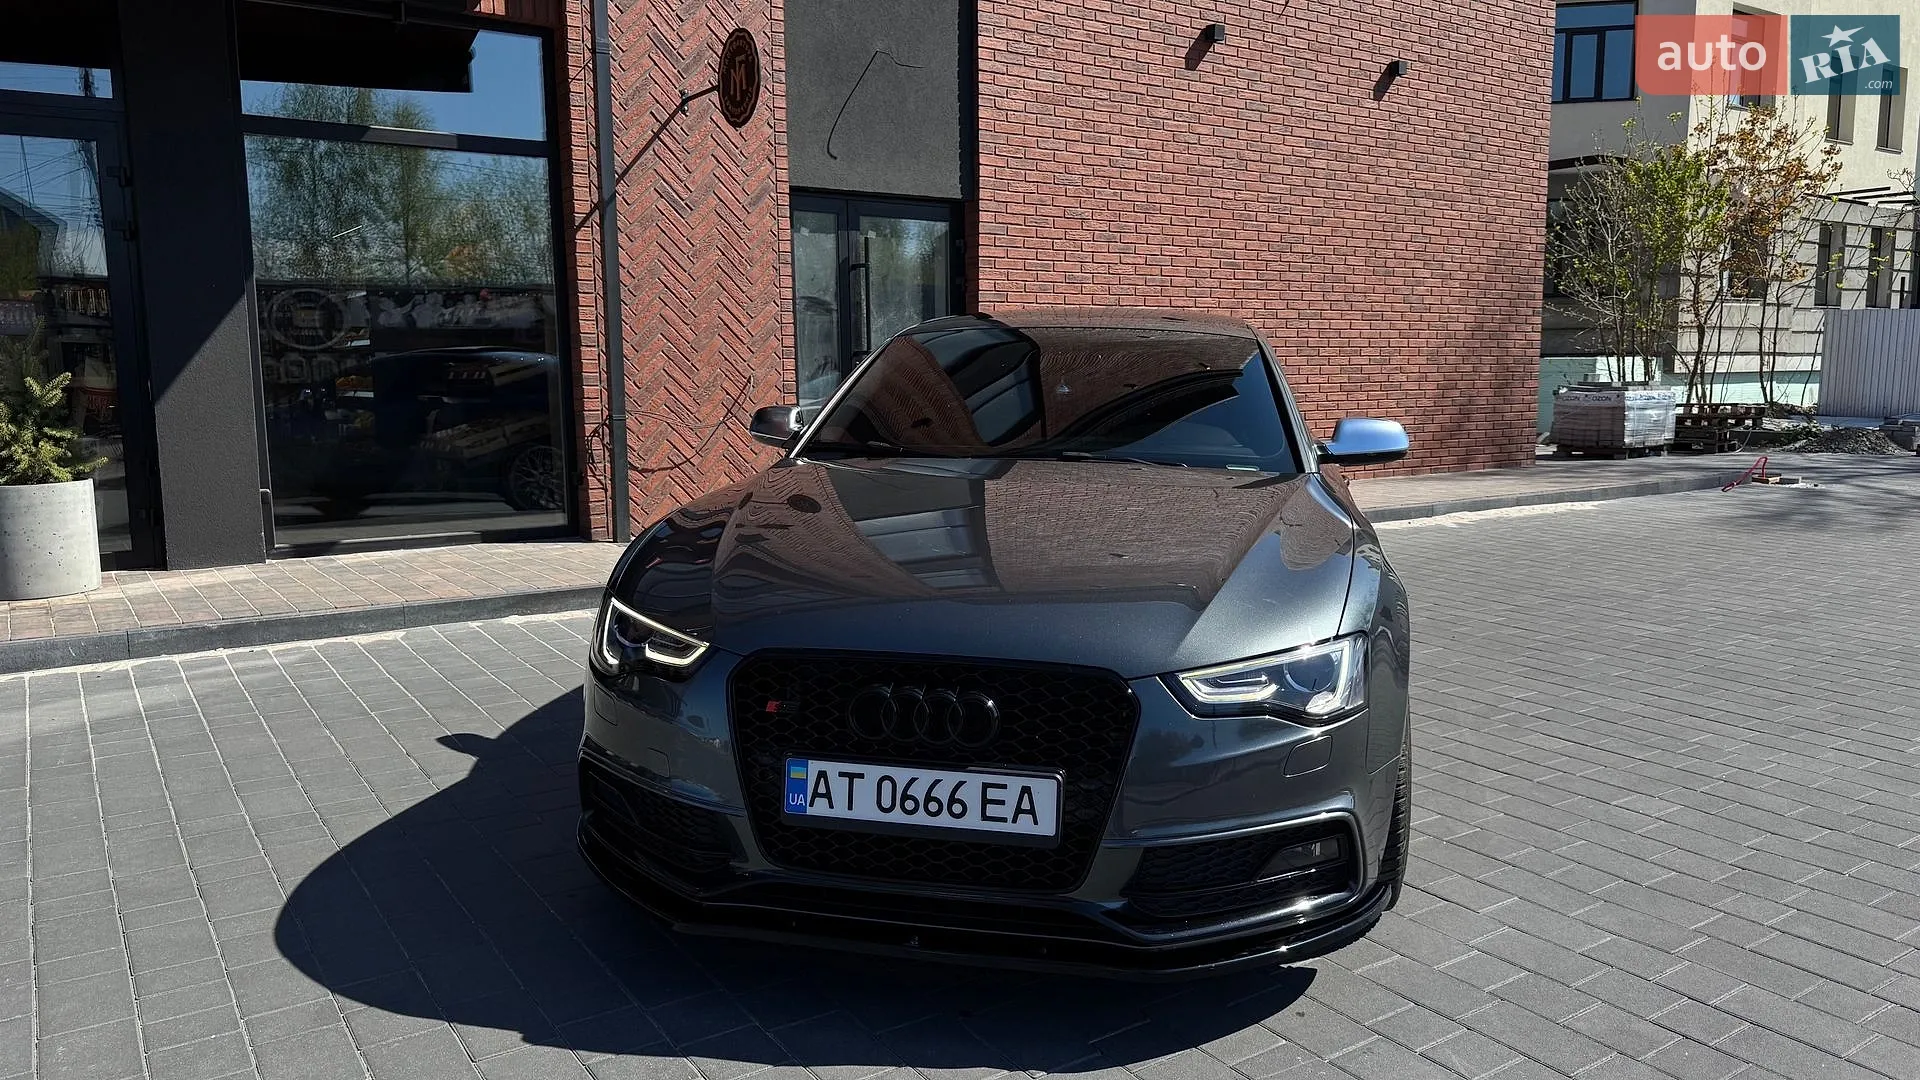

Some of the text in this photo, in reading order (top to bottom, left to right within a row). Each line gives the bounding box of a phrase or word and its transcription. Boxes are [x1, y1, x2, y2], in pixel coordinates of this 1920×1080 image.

[789, 793, 806, 806] UA
[808, 770, 1039, 826] AT 0666 EA
